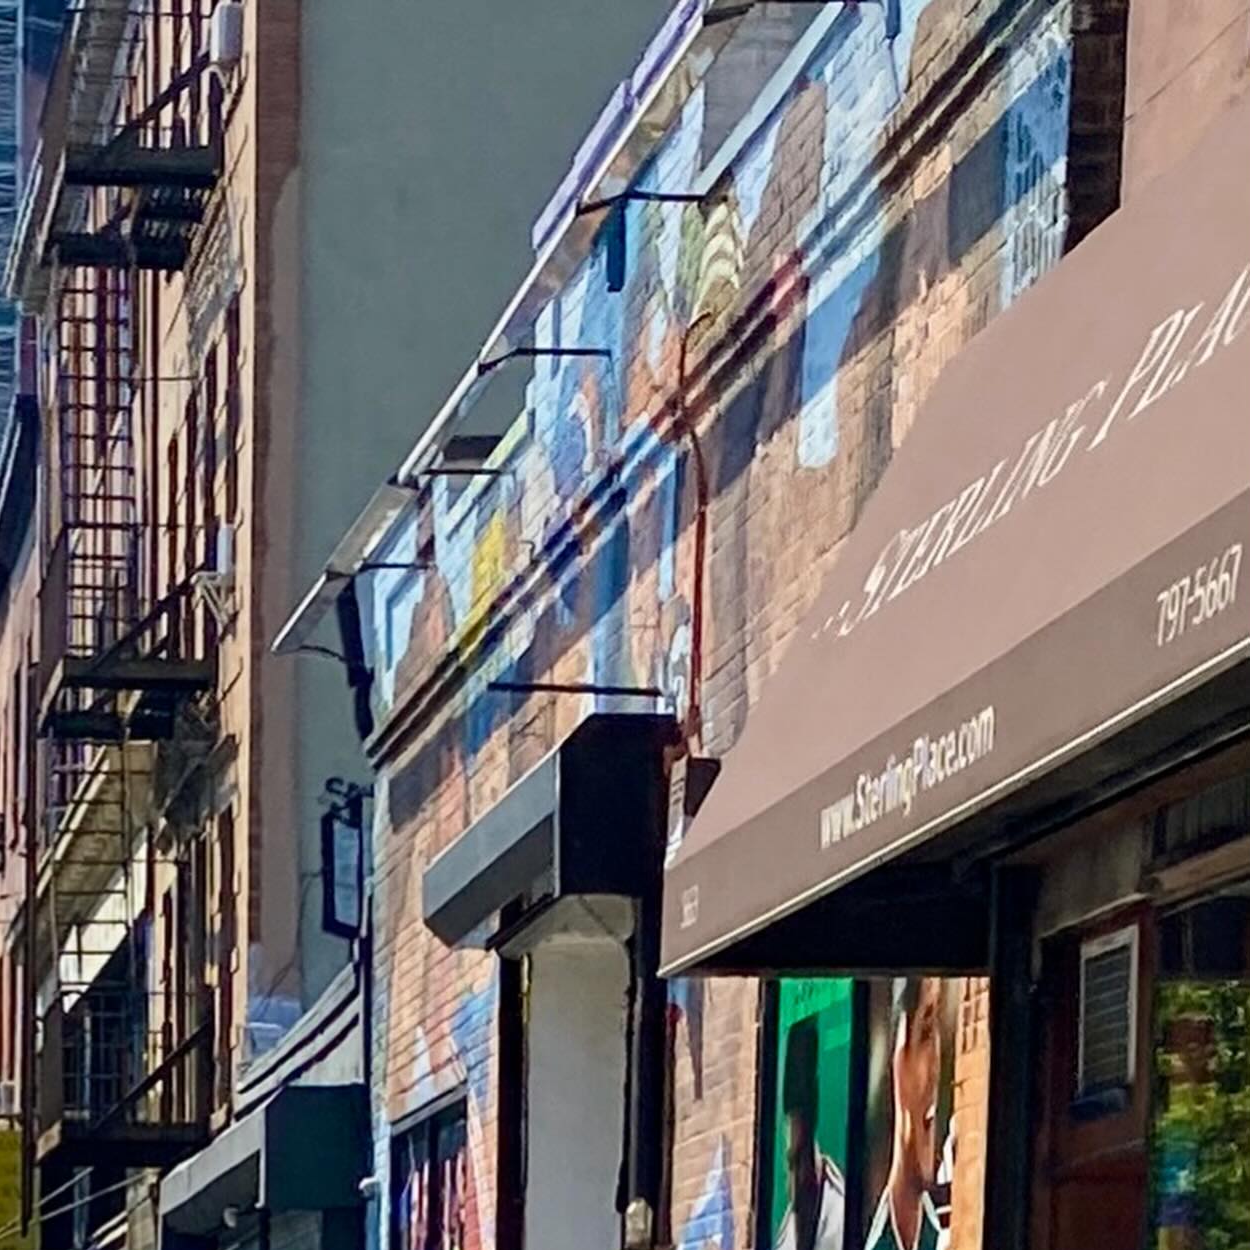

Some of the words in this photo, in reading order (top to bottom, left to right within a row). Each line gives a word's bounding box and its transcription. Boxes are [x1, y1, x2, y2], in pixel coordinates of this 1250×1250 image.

[840, 375, 1109, 634] STERLING
[1157, 544, 1242, 648] 797-5667
[820, 705, 994, 850] www.SterlingPlace.com
